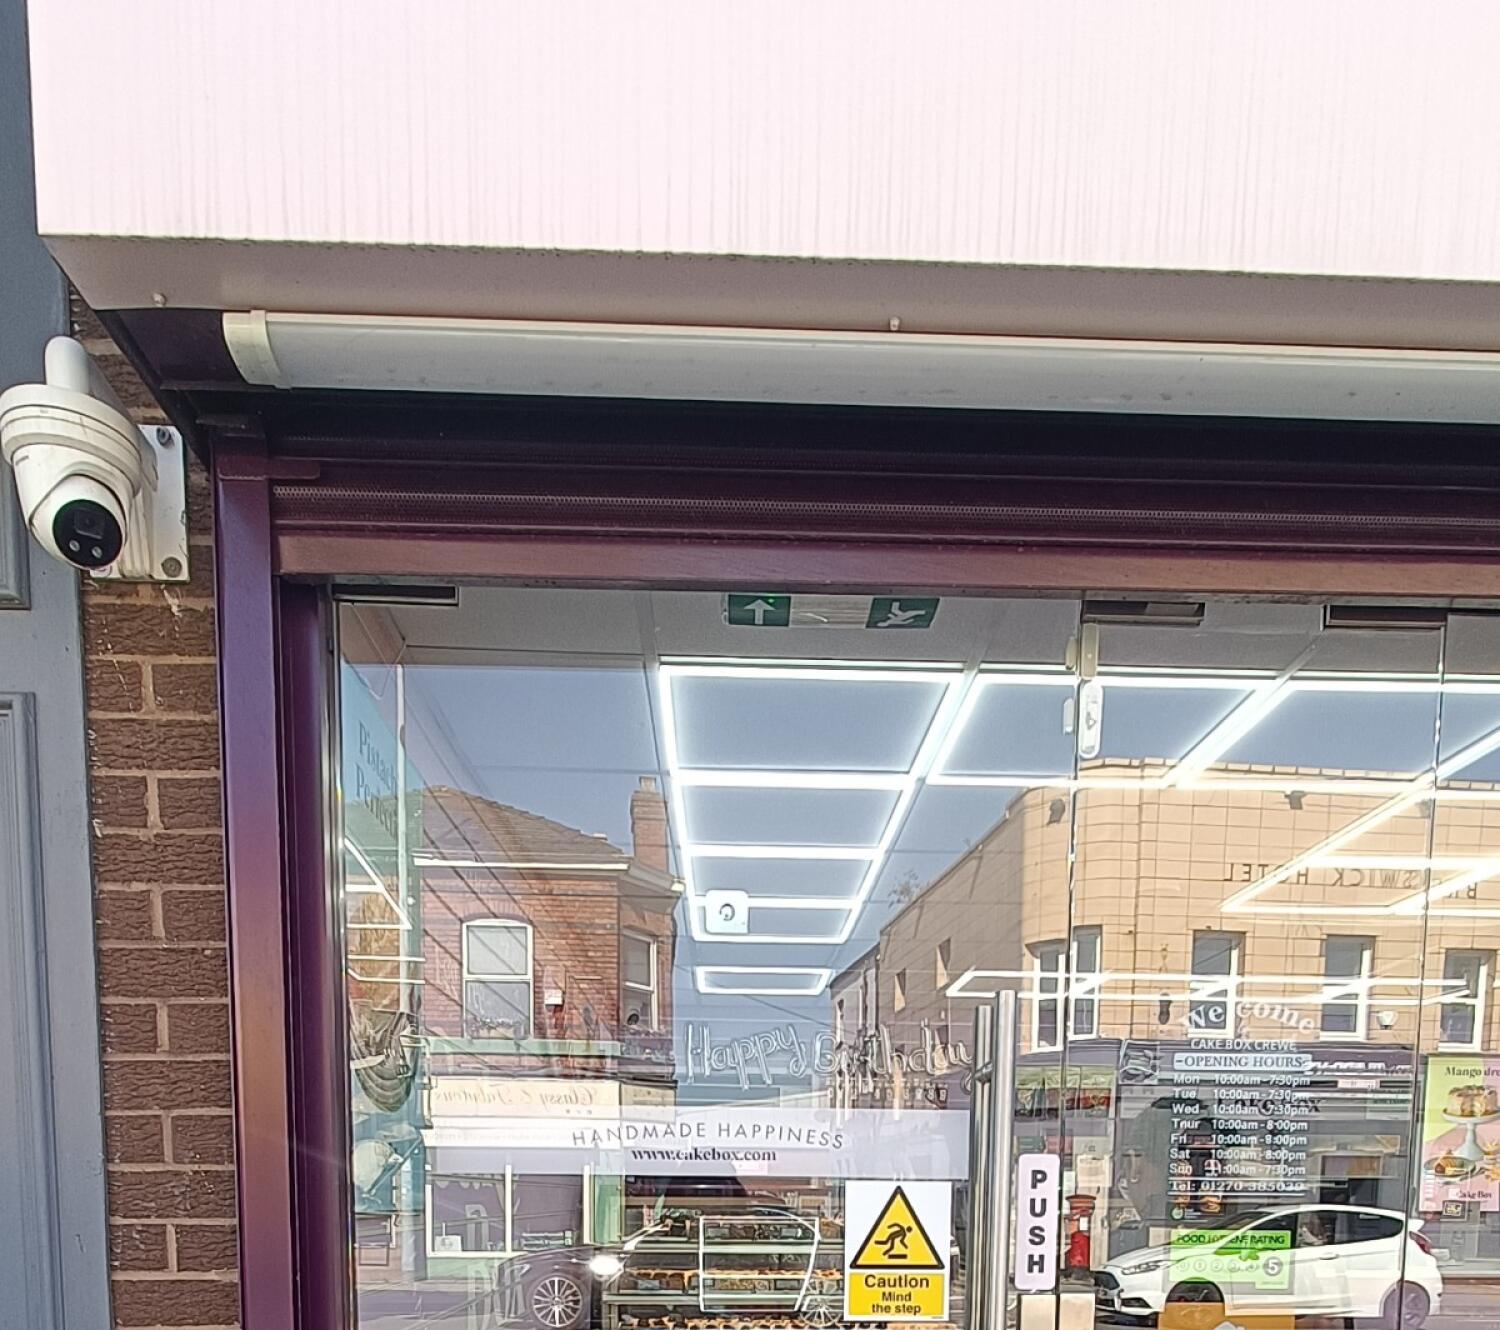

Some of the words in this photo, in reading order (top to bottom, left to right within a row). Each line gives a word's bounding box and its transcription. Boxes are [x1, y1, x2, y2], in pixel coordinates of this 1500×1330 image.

[1190, 1040, 1223, 1051] CAKE
[1225, 1040, 1251, 1051] BOX
[1254, 1040, 1297, 1052] CREWE
[685, 1022, 806, 1090] Happy
[1445, 1066, 1482, 1078] Mango
[1173, 1074, 1200, 1085] Mon
[1173, 1088, 1196, 1099] Tue
[1171, 1103, 1200, 1114] Wed
[1171, 1118, 1199, 1129] Thur
[573, 1123, 706, 1146] HANDMADE
[718, 1123, 843, 1150] HAPPINESS
[1170, 1134, 1187, 1144] Fri
[632, 1147, 777, 1161] www.cakebox.com
[1169, 1149, 1190, 1159] Sat
[1169, 1163, 1193, 1175] Sun
[1027, 1169, 1047, 1274] PUSH
[1250, 1235, 1286, 1245] RATING
[864, 1274, 930, 1289] Caution
[881, 1291, 912, 1302] Mind
[872, 1303, 891, 1314] the
[894, 1303, 922, 1316] step
